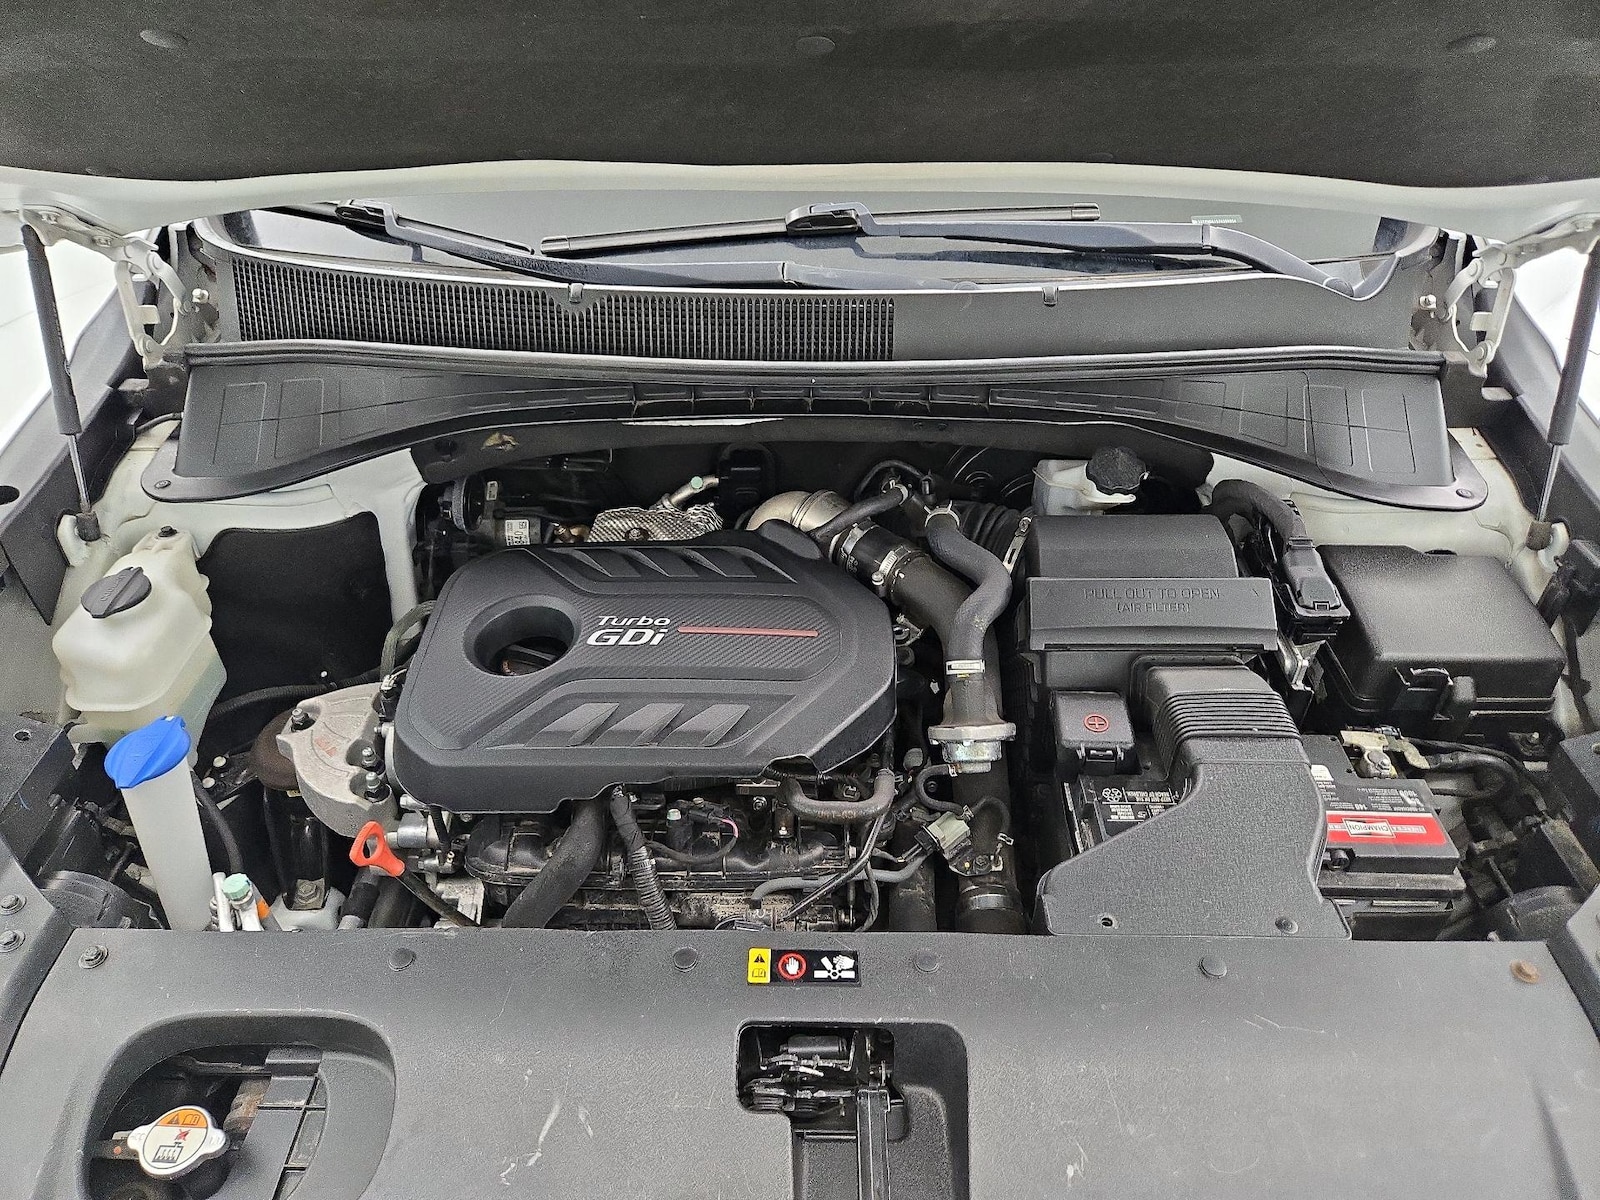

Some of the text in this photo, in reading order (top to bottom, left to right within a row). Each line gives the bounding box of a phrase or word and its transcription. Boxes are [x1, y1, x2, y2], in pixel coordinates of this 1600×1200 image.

[1083, 588, 1221, 599] PULL OUT TO OPEN
[598, 615, 671, 626] Turbo
[586, 628, 669, 646] GDi
[1348, 823, 1389, 832] CHAMPION
